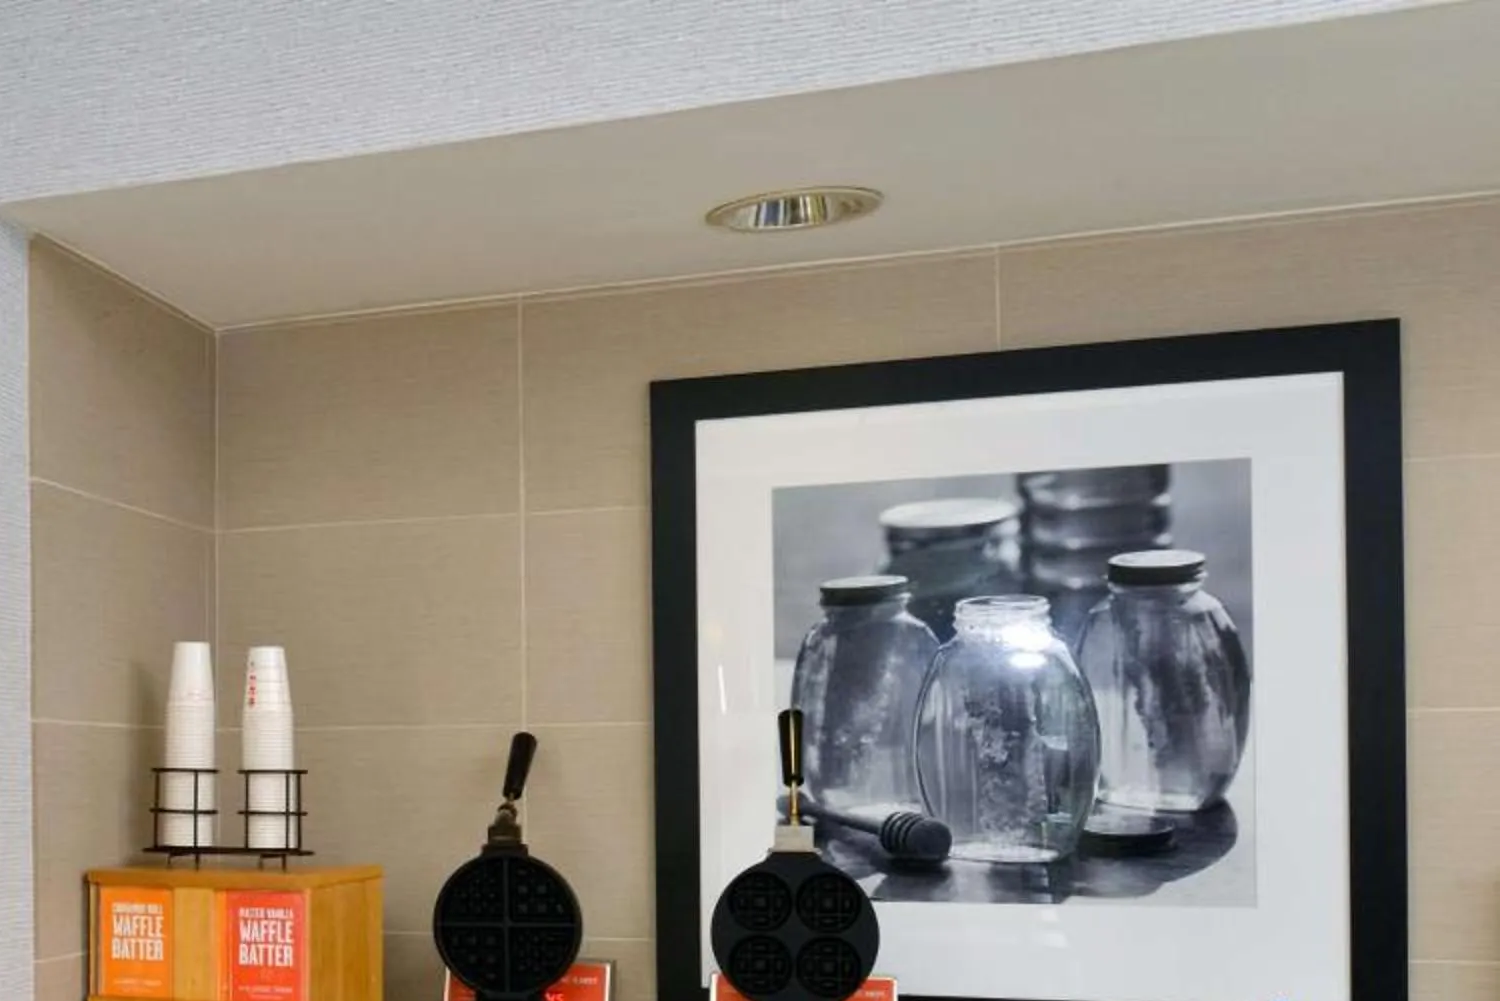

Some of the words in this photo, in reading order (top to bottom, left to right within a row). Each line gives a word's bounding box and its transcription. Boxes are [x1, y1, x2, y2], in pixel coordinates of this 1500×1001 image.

[112, 915, 165, 938] WAFFLE
[239, 919, 295, 943] WAFFLE
[111, 937, 165, 961] BATTER
[238, 943, 295, 967] BATTER
